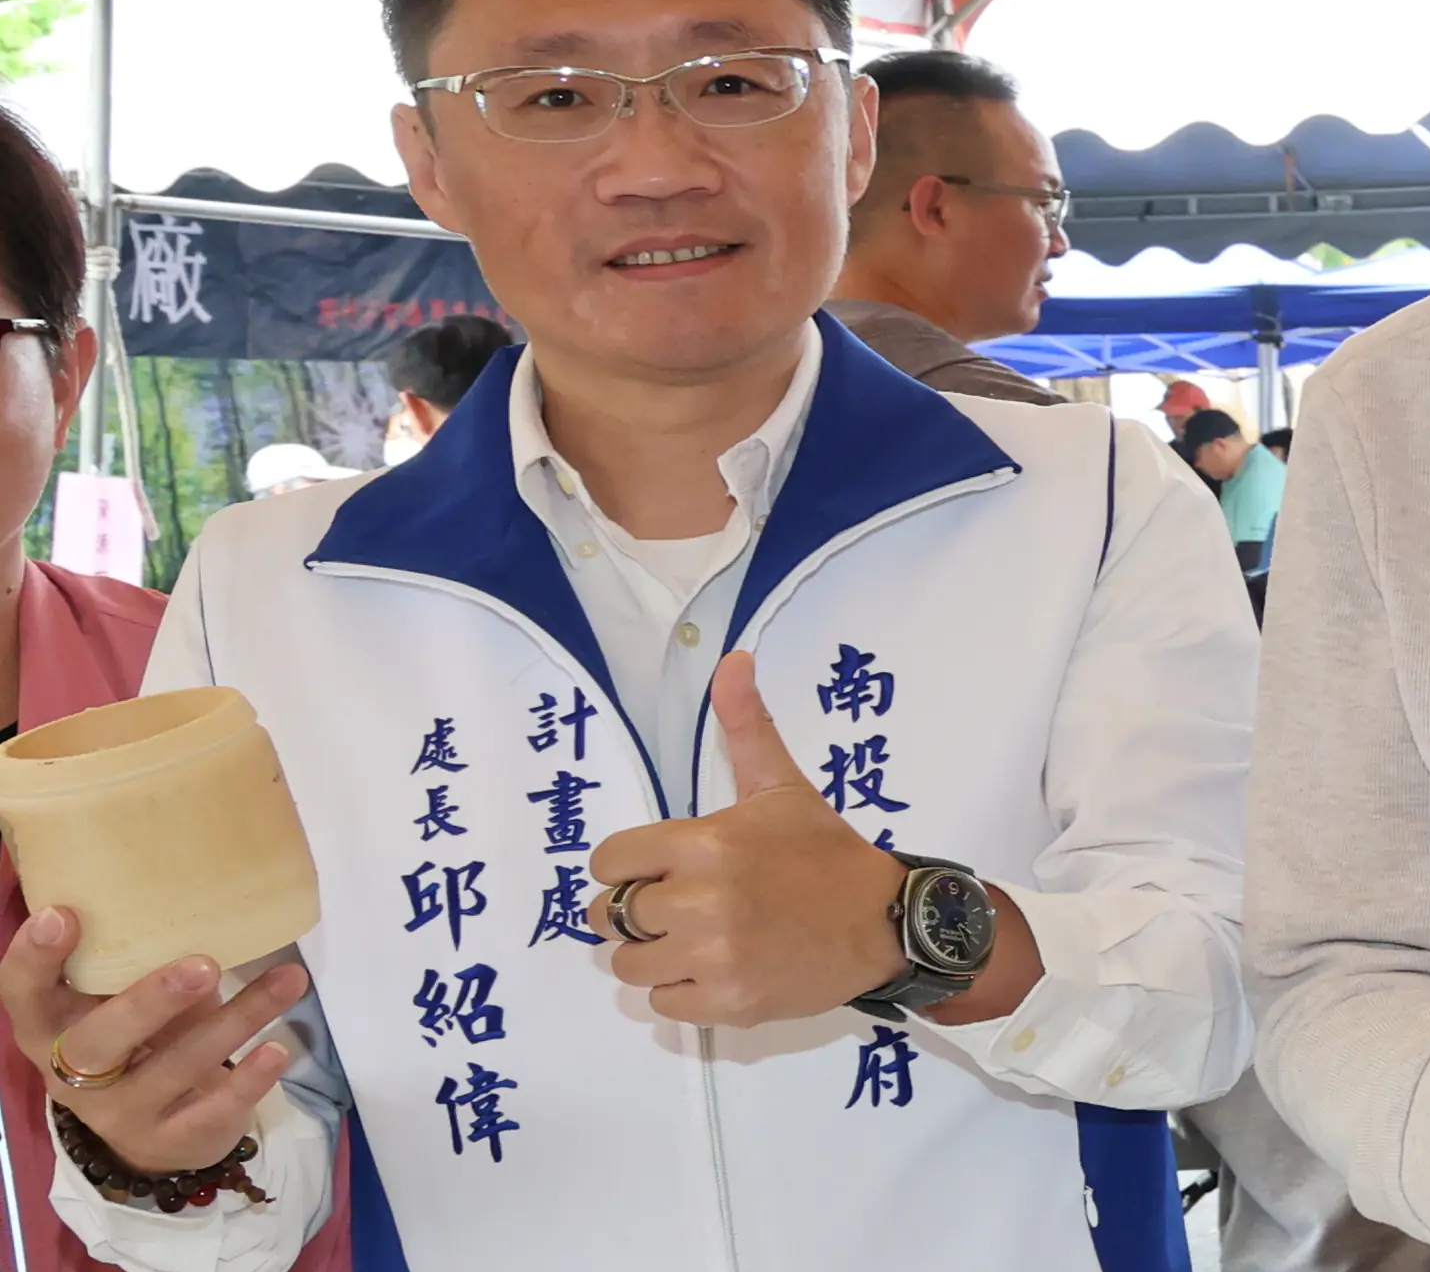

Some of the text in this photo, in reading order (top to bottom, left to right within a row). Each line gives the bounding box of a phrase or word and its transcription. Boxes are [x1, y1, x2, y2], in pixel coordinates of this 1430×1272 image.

[128, 213, 213, 324] 廠
[526, 686, 606, 948] 計畫處
